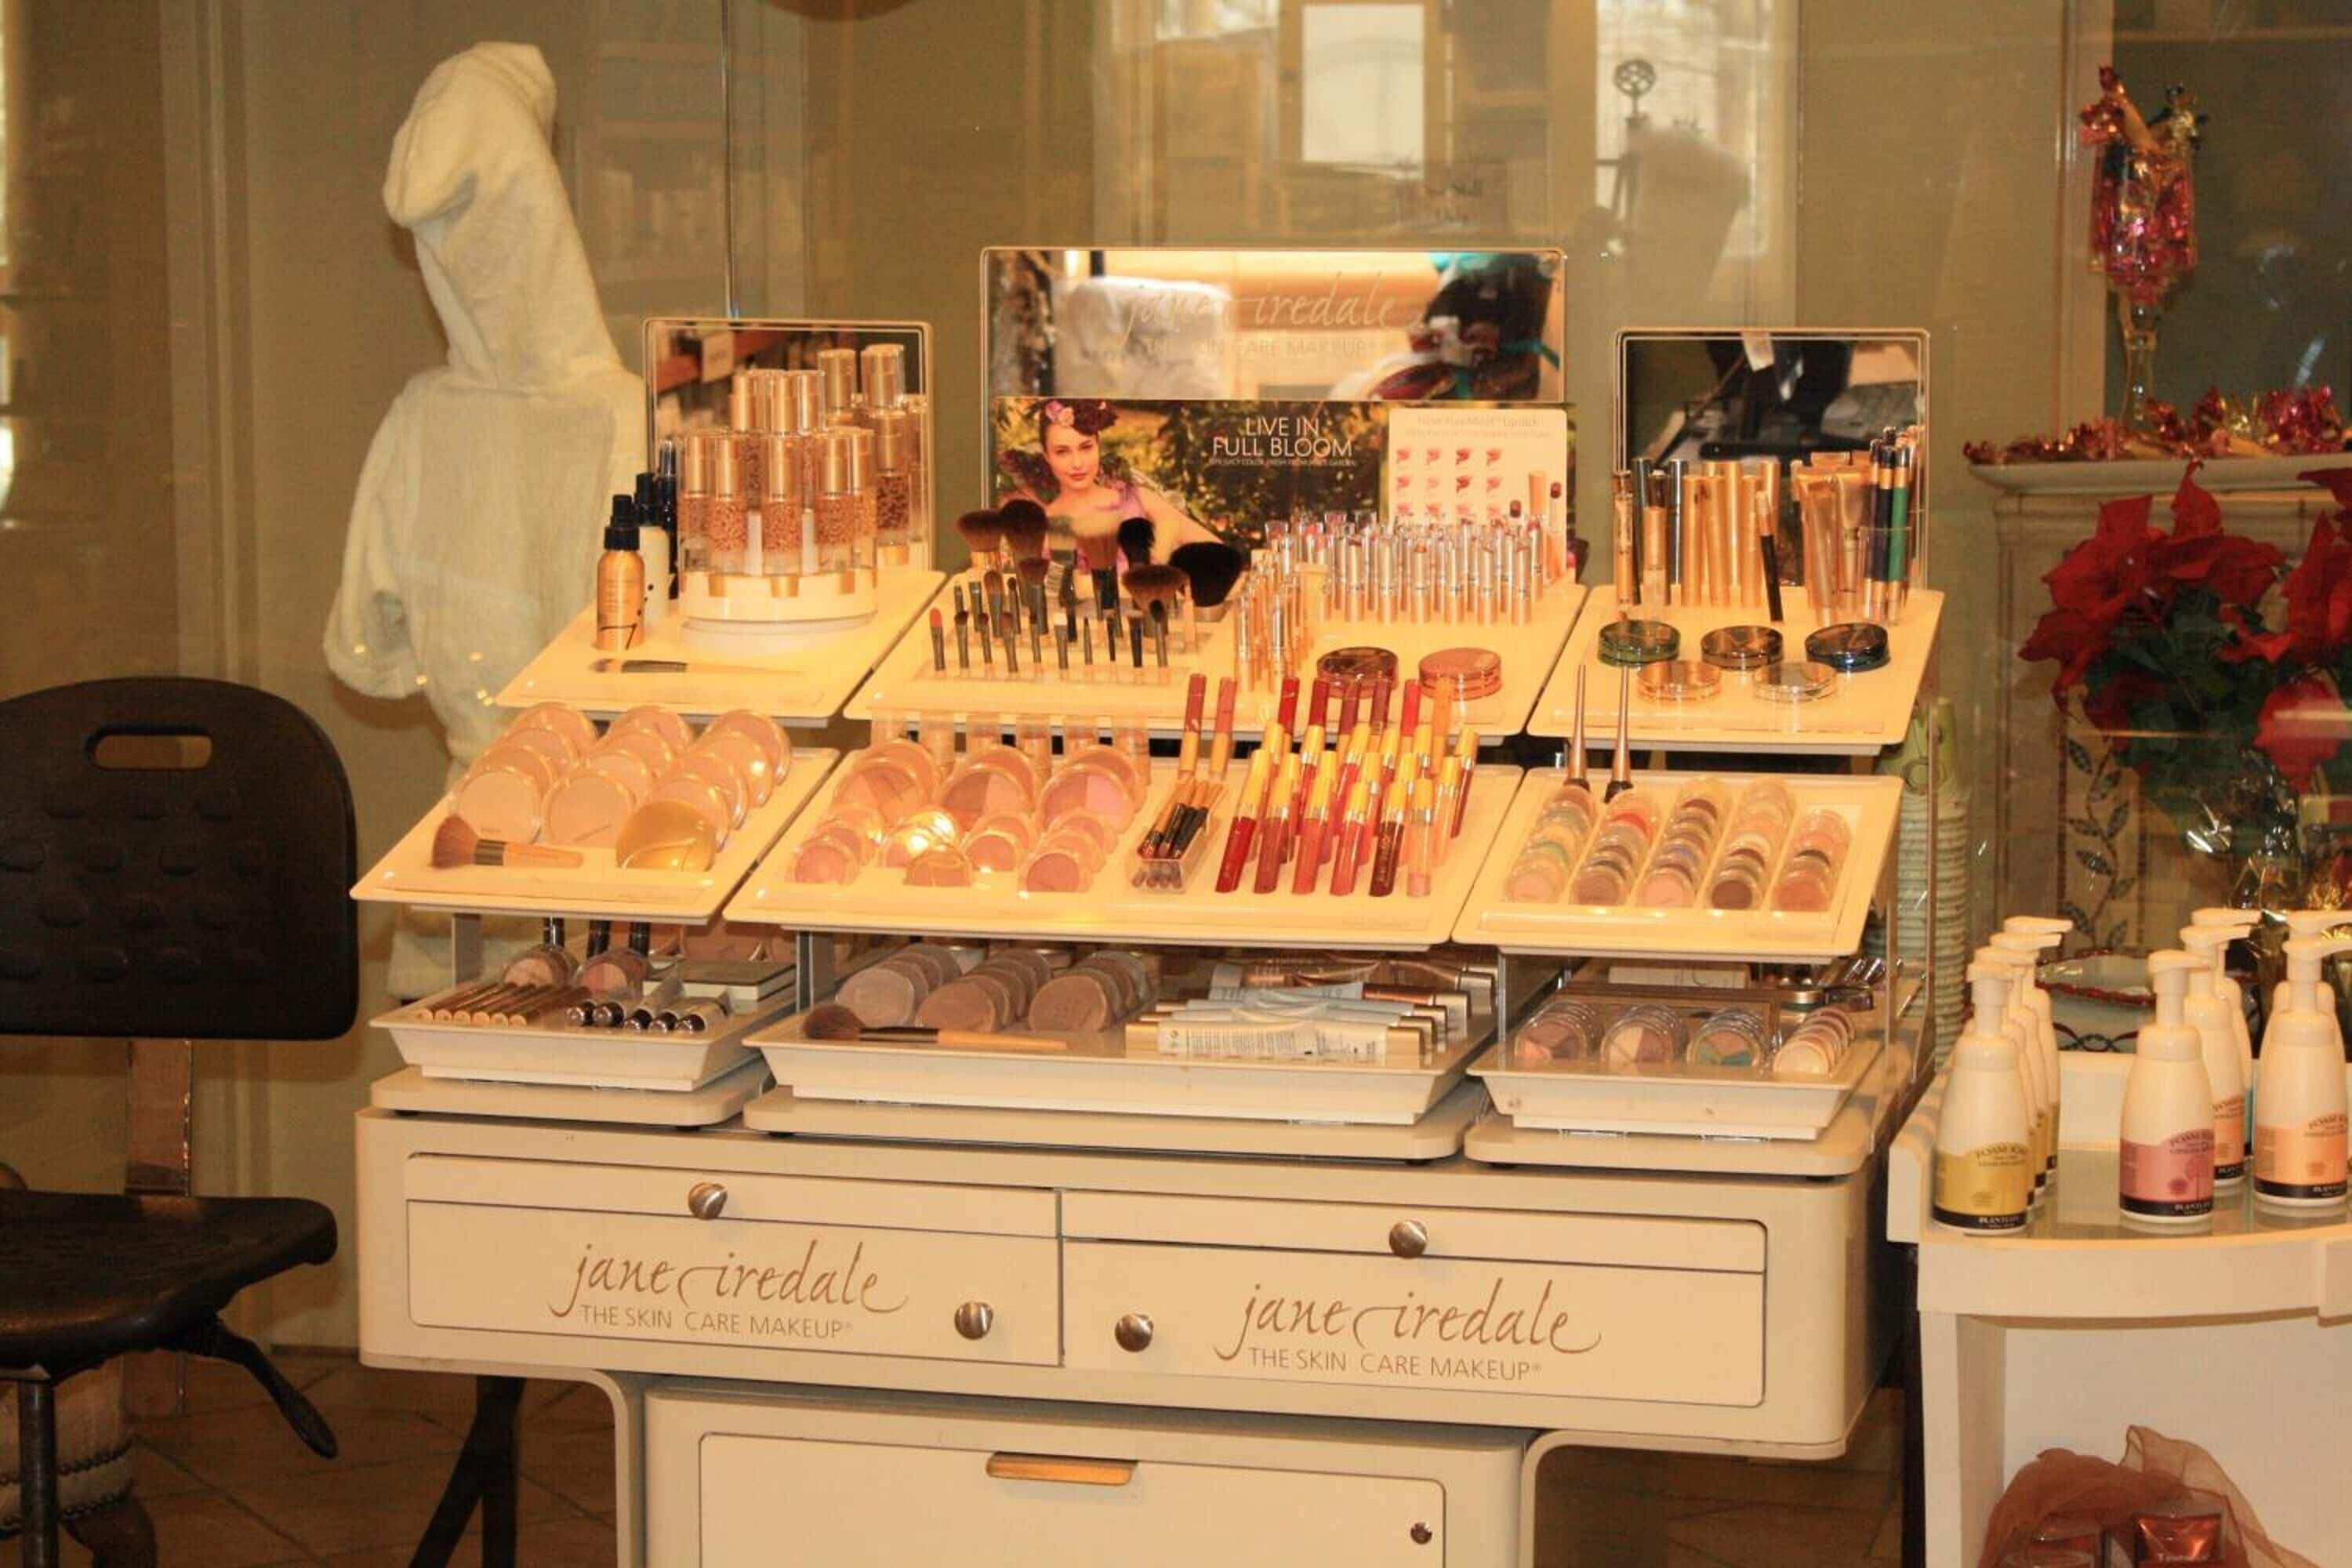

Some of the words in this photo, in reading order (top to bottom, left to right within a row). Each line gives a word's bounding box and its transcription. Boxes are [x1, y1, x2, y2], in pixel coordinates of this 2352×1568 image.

[1229, 270, 1423, 330] iredale
[1246, 417, 1289, 436] LIVE
[1296, 417, 1319, 437] IN
[1213, 437, 1263, 456] FULL
[1270, 437, 1352, 457] BLOOM
[549, 1243, 673, 1317] jane
[677, 1240, 909, 1313] iredale
[579, 1304, 619, 1327] THE
[626, 1307, 672, 1329] SKIN
[684, 1311, 741, 1334] CARE
[1214, 1283, 1353, 1361] jane
[1353, 1277, 1602, 1355] iredale
[1247, 1346, 1290, 1369] THE
[1296, 1348, 1346, 1372] SKIN
[1360, 1352, 1422, 1377] CARE
